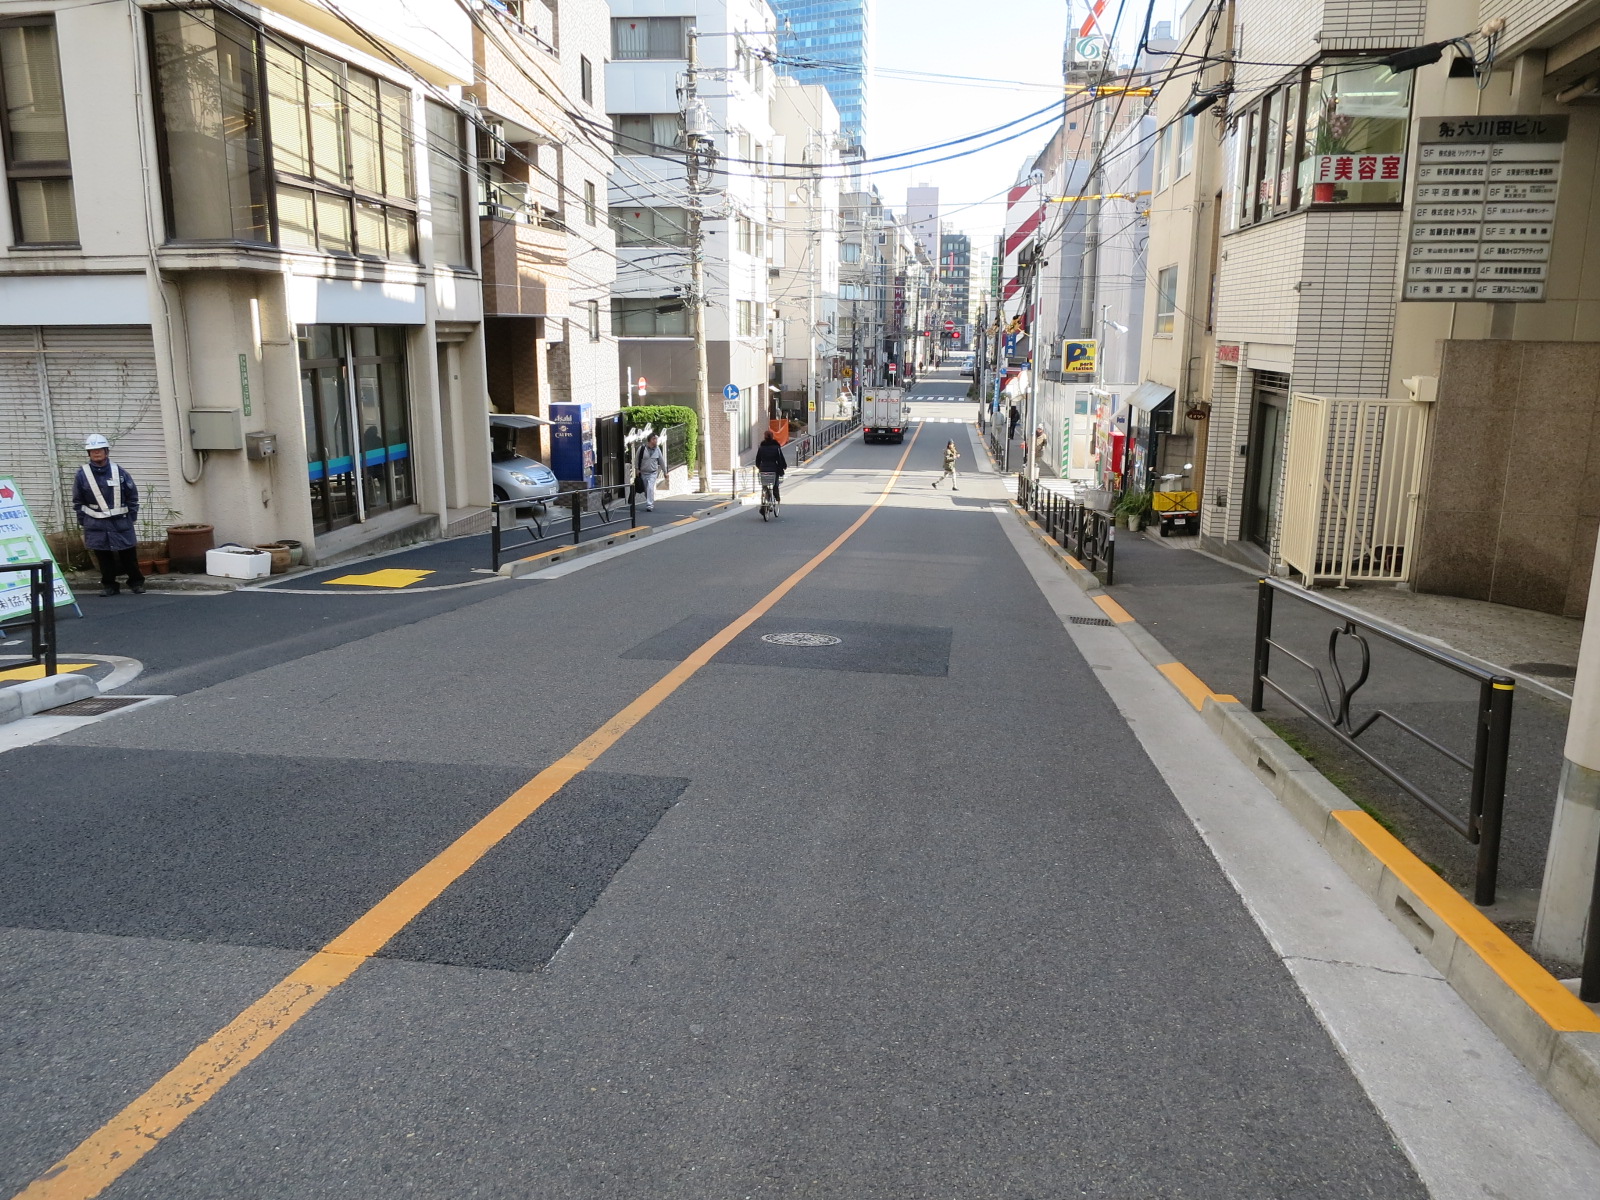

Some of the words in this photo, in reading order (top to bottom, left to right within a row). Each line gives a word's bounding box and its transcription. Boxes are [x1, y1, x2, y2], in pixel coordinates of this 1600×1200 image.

[1423, 149, 1434, 157] 3F
[1492, 148, 1504, 157] 6F
[1334, 155, 1401, 181] 美容室
[1420, 168, 1431, 177] 3F
[1491, 168, 1502, 177] 6F
[1418, 188, 1429, 197] 3F
[1489, 188, 1501, 197] 6F
[1416, 208, 1428, 217] 2F
[1414, 228, 1426, 237] 2F
[1485, 227, 1497, 236] 5F
[1412, 247, 1424, 256] 2F
[1484, 247, 1495, 255] 4F
[1411, 266, 1421, 275] 1F
[1480, 266, 1491, 275] 4F
[1409, 285, 1419, 294] 1F
[1476, 285, 1488, 294] 4F
